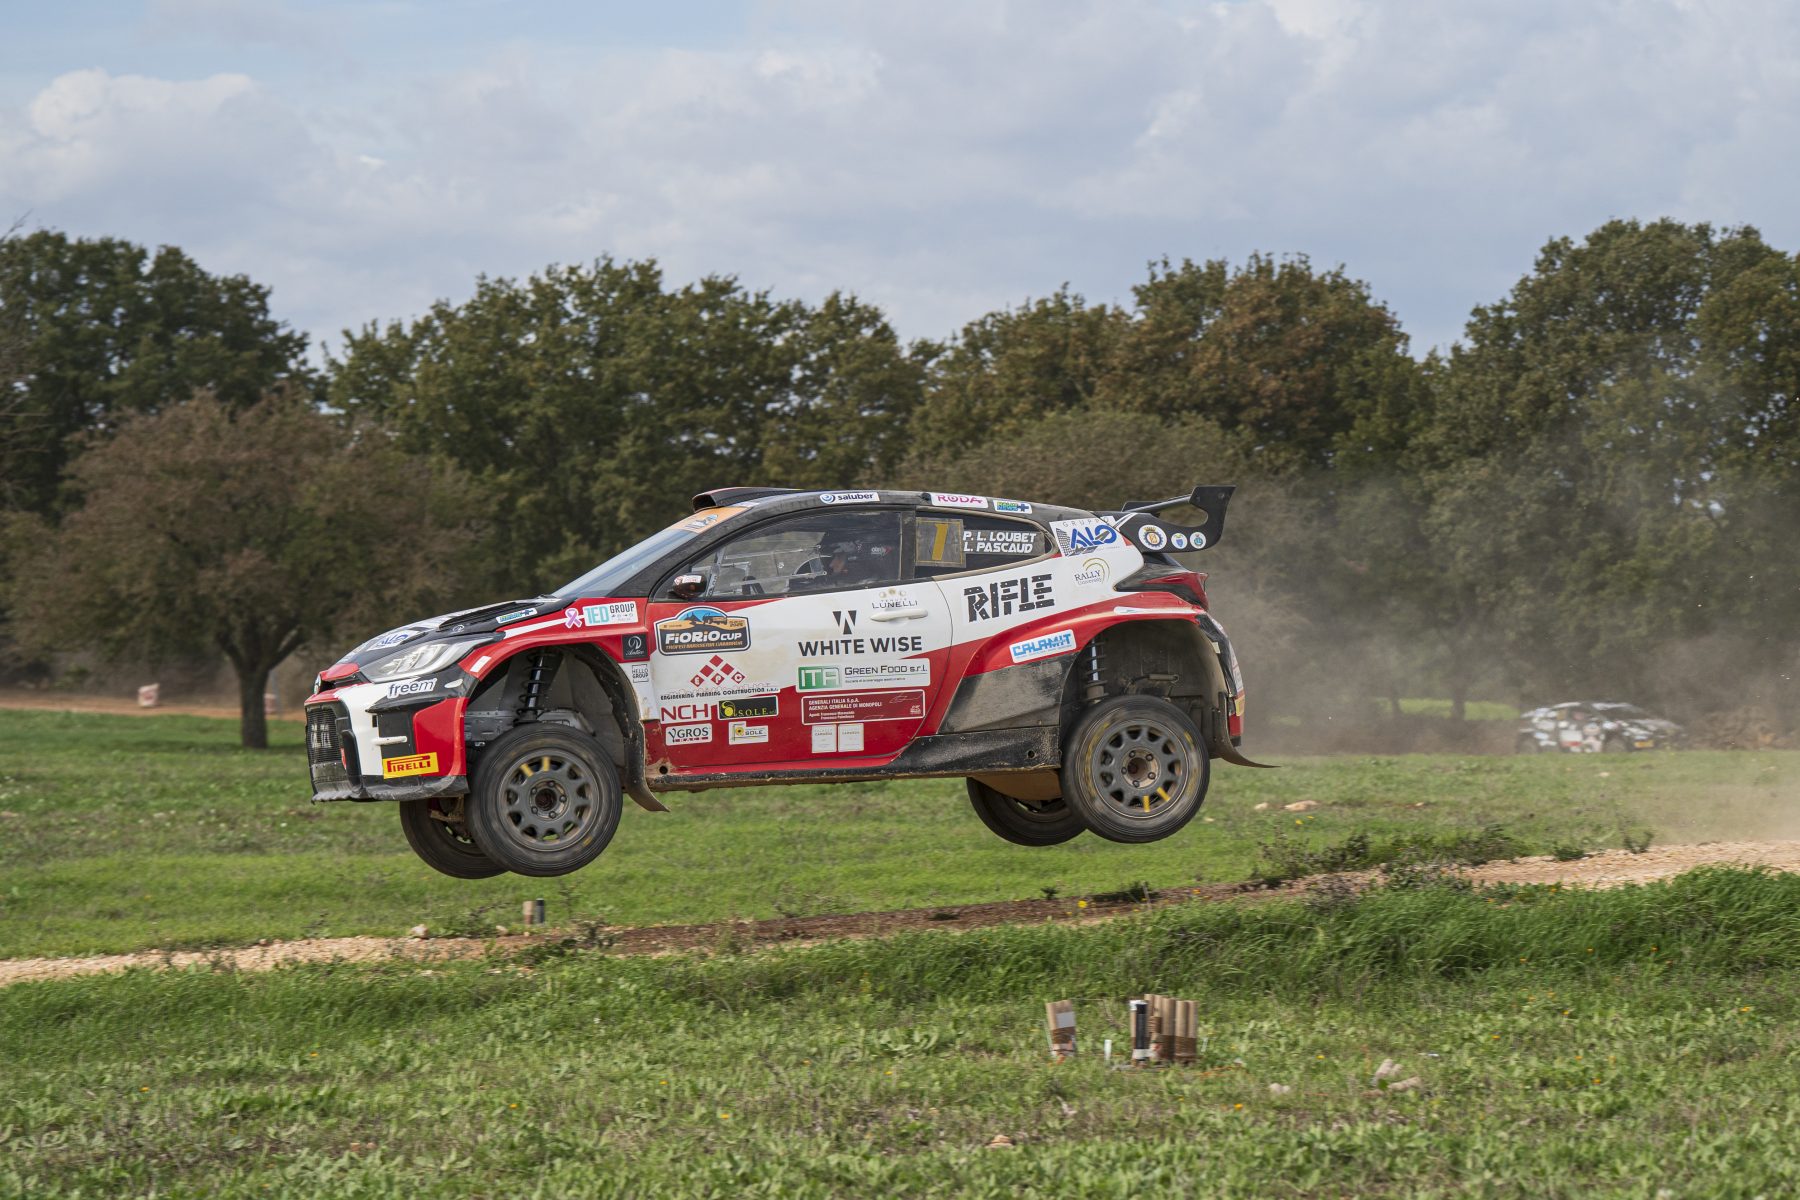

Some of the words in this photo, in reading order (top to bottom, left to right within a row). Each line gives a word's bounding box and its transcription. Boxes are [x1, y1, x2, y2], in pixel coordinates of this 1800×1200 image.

[931, 523, 949, 561] 1
[962, 531, 974, 541] P.
[976, 531, 987, 541] L.
[989, 531, 1037, 543] LOUBET
[963, 541, 974, 552] L.
[976, 542, 1033, 553] PASCAUD
[1074, 570, 1101, 581] RALLY
[871, 599, 918, 609] LUNELLI
[963, 573, 1055, 622] RIFLE
[609, 603, 635, 614] GROUP
[720, 632, 743, 641] CUP
[798, 638, 865, 657] WHITE
[869, 635, 923, 653] WISE
[844, 666, 879, 676] GREEN
[880, 665, 908, 674] FOOD
[389, 680, 435, 695] freem
[660, 693, 695, 701] ENGINEERING
[695, 690, 721, 698] PLANNING
[722, 687, 765, 696] CONSTRUCTION
[660, 703, 709, 722] NCH
[386, 755, 431, 773] PIRELLI
